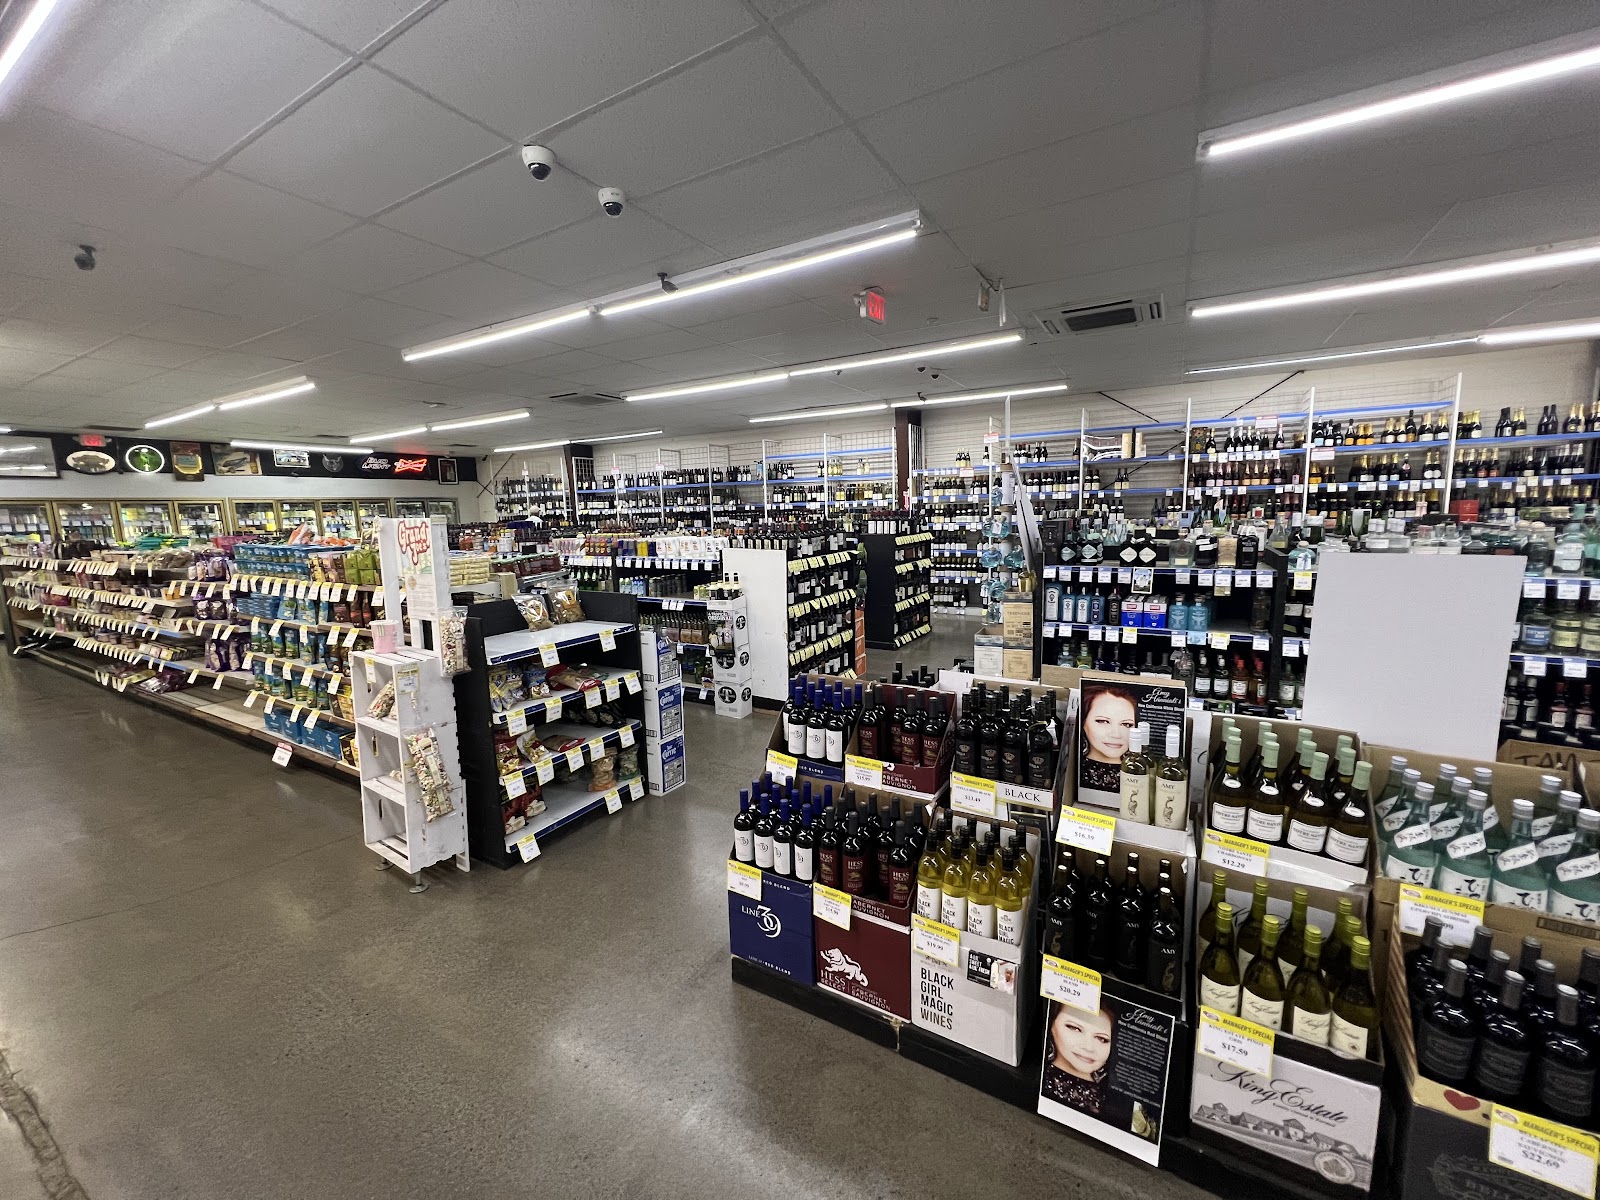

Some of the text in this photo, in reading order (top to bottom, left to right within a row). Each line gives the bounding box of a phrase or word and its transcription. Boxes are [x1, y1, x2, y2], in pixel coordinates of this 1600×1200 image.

[882, 774, 912, 784] ABERNET
[882, 780, 917, 790] AUVIGNON
[1004, 788, 1041, 803] BLACK
[1250, 845, 1267, 854] SPECIAL
[1222, 858, 1246, 869] $12.29
[774, 882, 791, 891] BLEND
[852, 900, 886, 914] ABERNET
[852, 904, 890, 920] AUVIGNON
[1424, 894, 1482, 913] MANAGER'S SPECIAL
[742, 905, 782, 938] LINE 39
[820, 969, 846, 986] HESS
[820, 978, 846, 992] SELECT
[920, 967, 954, 991] BLACK
[852, 985, 887, 1004] CABERNET
[920, 980, 944, 1000] GIRL
[1060, 985, 1080, 996] $20.29
[852, 990, 891, 1012] SAUVIGNON
[920, 994, 954, 1016] MAGIC
[920, 1007, 953, 1031] WINES
[1222, 1018, 1272, 1042] MANAGER'S SPECIAL
[1222, 1042, 1248, 1056] $17.59
[1210, 1061, 1279, 1105] King
[1270, 1079, 1348, 1124] Estate
[1523, 1120, 1596, 1154] MANAGER'S SPECIAL
[1522, 1150, 1560, 1168] $22.69
